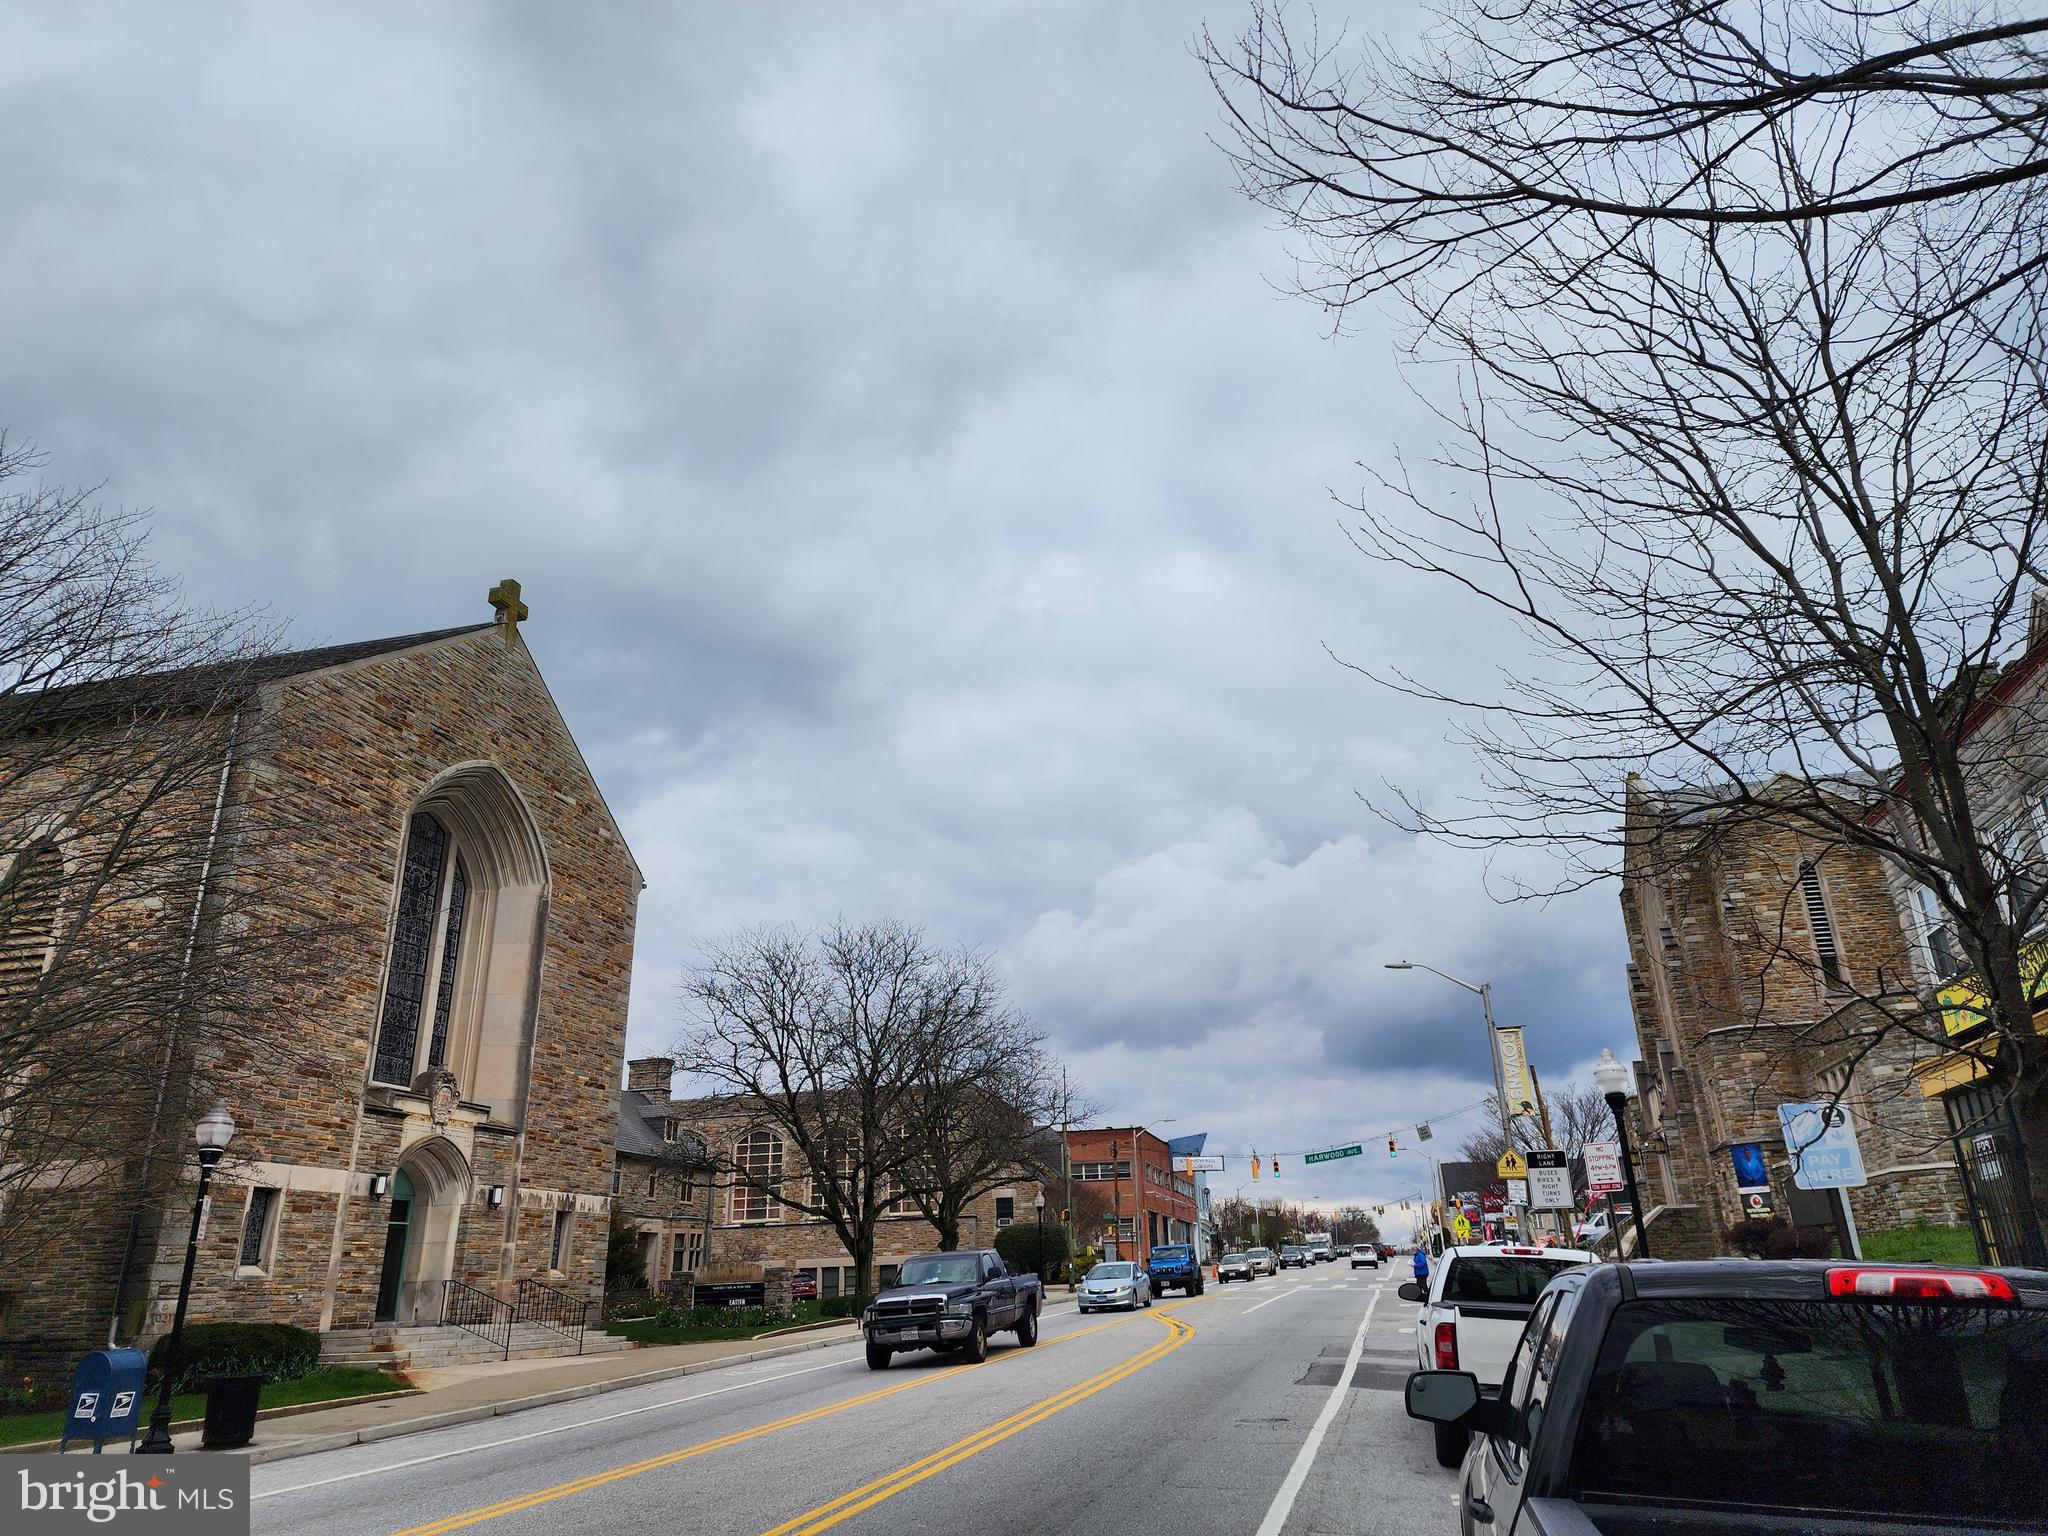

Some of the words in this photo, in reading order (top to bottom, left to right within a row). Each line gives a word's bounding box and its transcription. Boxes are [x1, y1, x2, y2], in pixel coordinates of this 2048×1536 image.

[1501, 1033, 1524, 1099] GOVANS
[1308, 1151, 1345, 1162] HARWOOD
[1588, 1154, 1615, 1162] STOPPING
[1808, 1153, 1840, 1167] PAY
[1810, 1168, 1854, 1181] HERE
